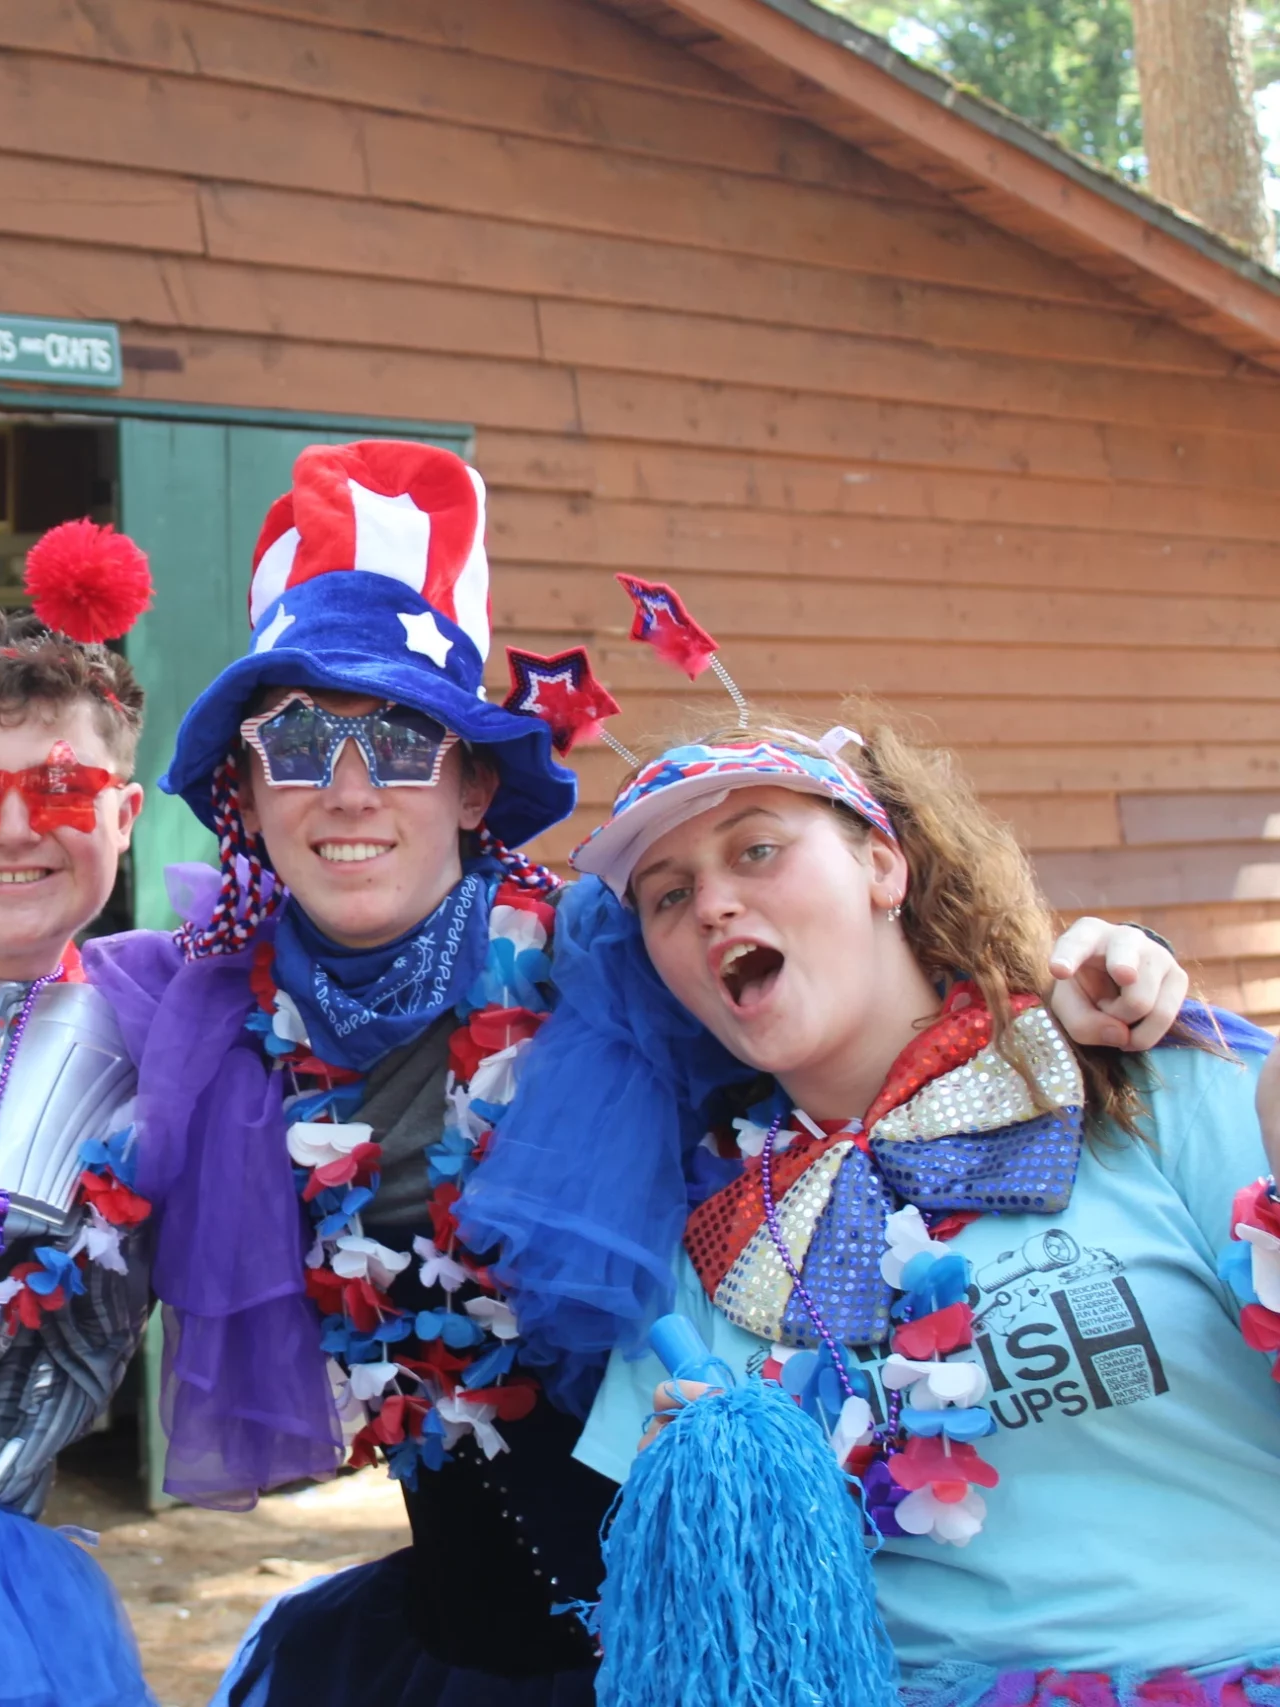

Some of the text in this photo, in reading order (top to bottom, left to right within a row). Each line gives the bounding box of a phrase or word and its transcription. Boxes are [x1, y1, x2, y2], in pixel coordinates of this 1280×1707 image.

[1067, 1281, 1112, 1296] DEDICATION
[1071, 1288, 1117, 1303] ACCEPTANCE
[1073, 1295, 1120, 1311] LEADERSHIP
[1075, 1310, 1091, 1319] FUN
[1099, 1303, 1124, 1315] SAFETY
[1078, 1311, 1130, 1328] ENTHUSIASM
[1094, 1347, 1143, 1364] COMPASSION
[1098, 1354, 1142, 1371] COMMUNITY
[1101, 1361, 1146, 1378] FRIENDSHIP
[1112, 1383, 1149, 1399] PATIENCE
[1115, 1390, 1152, 1406] RESPECT
